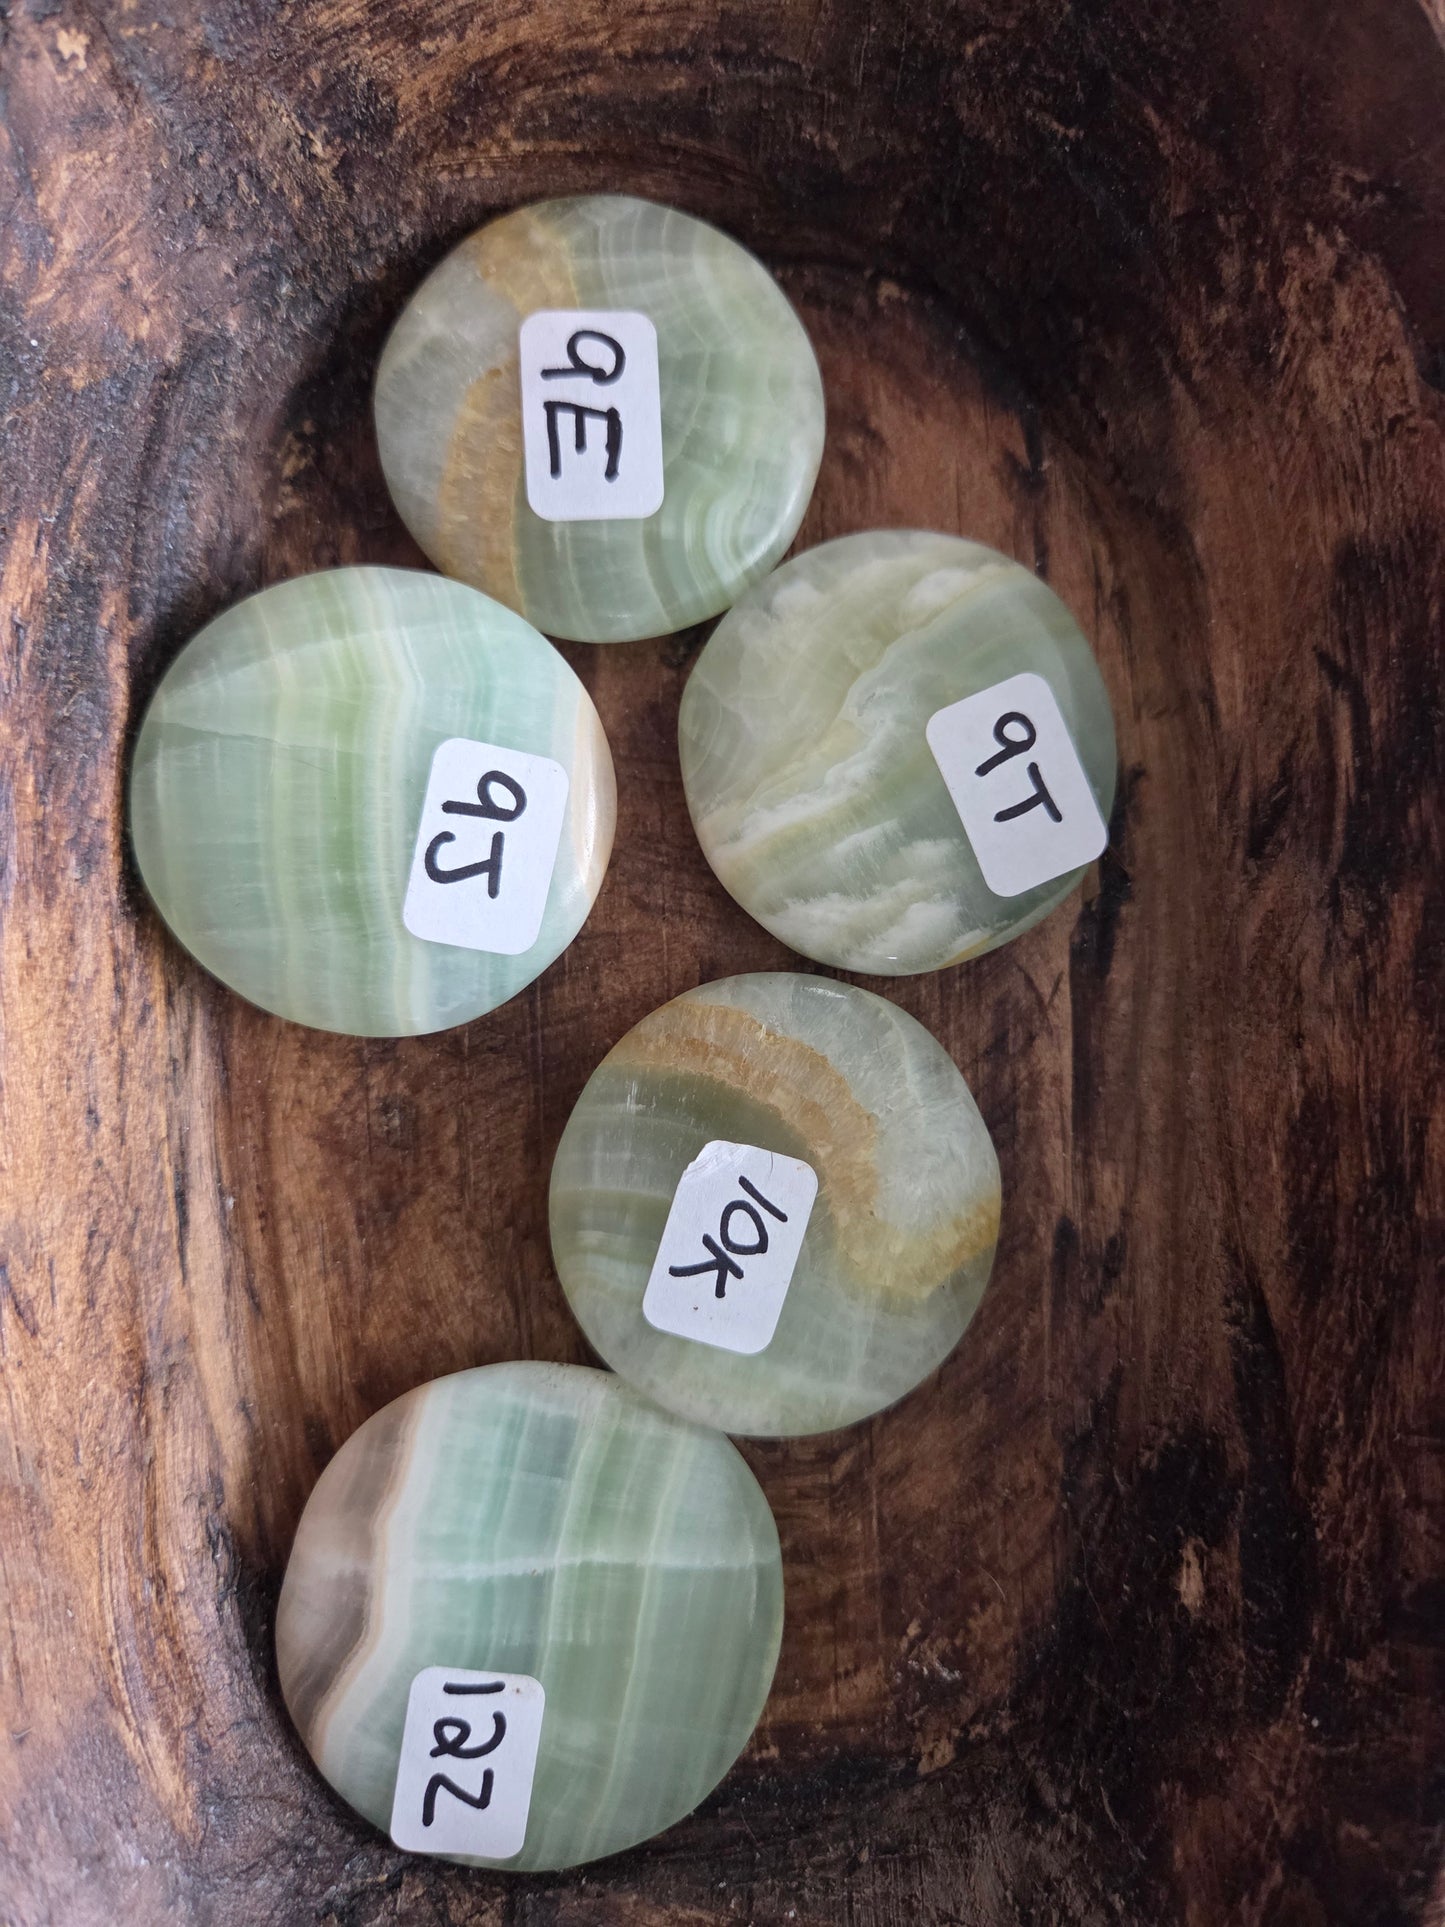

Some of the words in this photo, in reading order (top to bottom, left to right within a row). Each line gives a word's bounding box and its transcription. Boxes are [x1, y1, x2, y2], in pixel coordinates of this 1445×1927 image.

[541, 329, 626, 483] 9E
[974, 710, 1064, 824] 9T
[424, 770, 527, 899] 9J
[668, 1175, 788, 1299] 10K
[421, 1680, 507, 1828] 12Z
